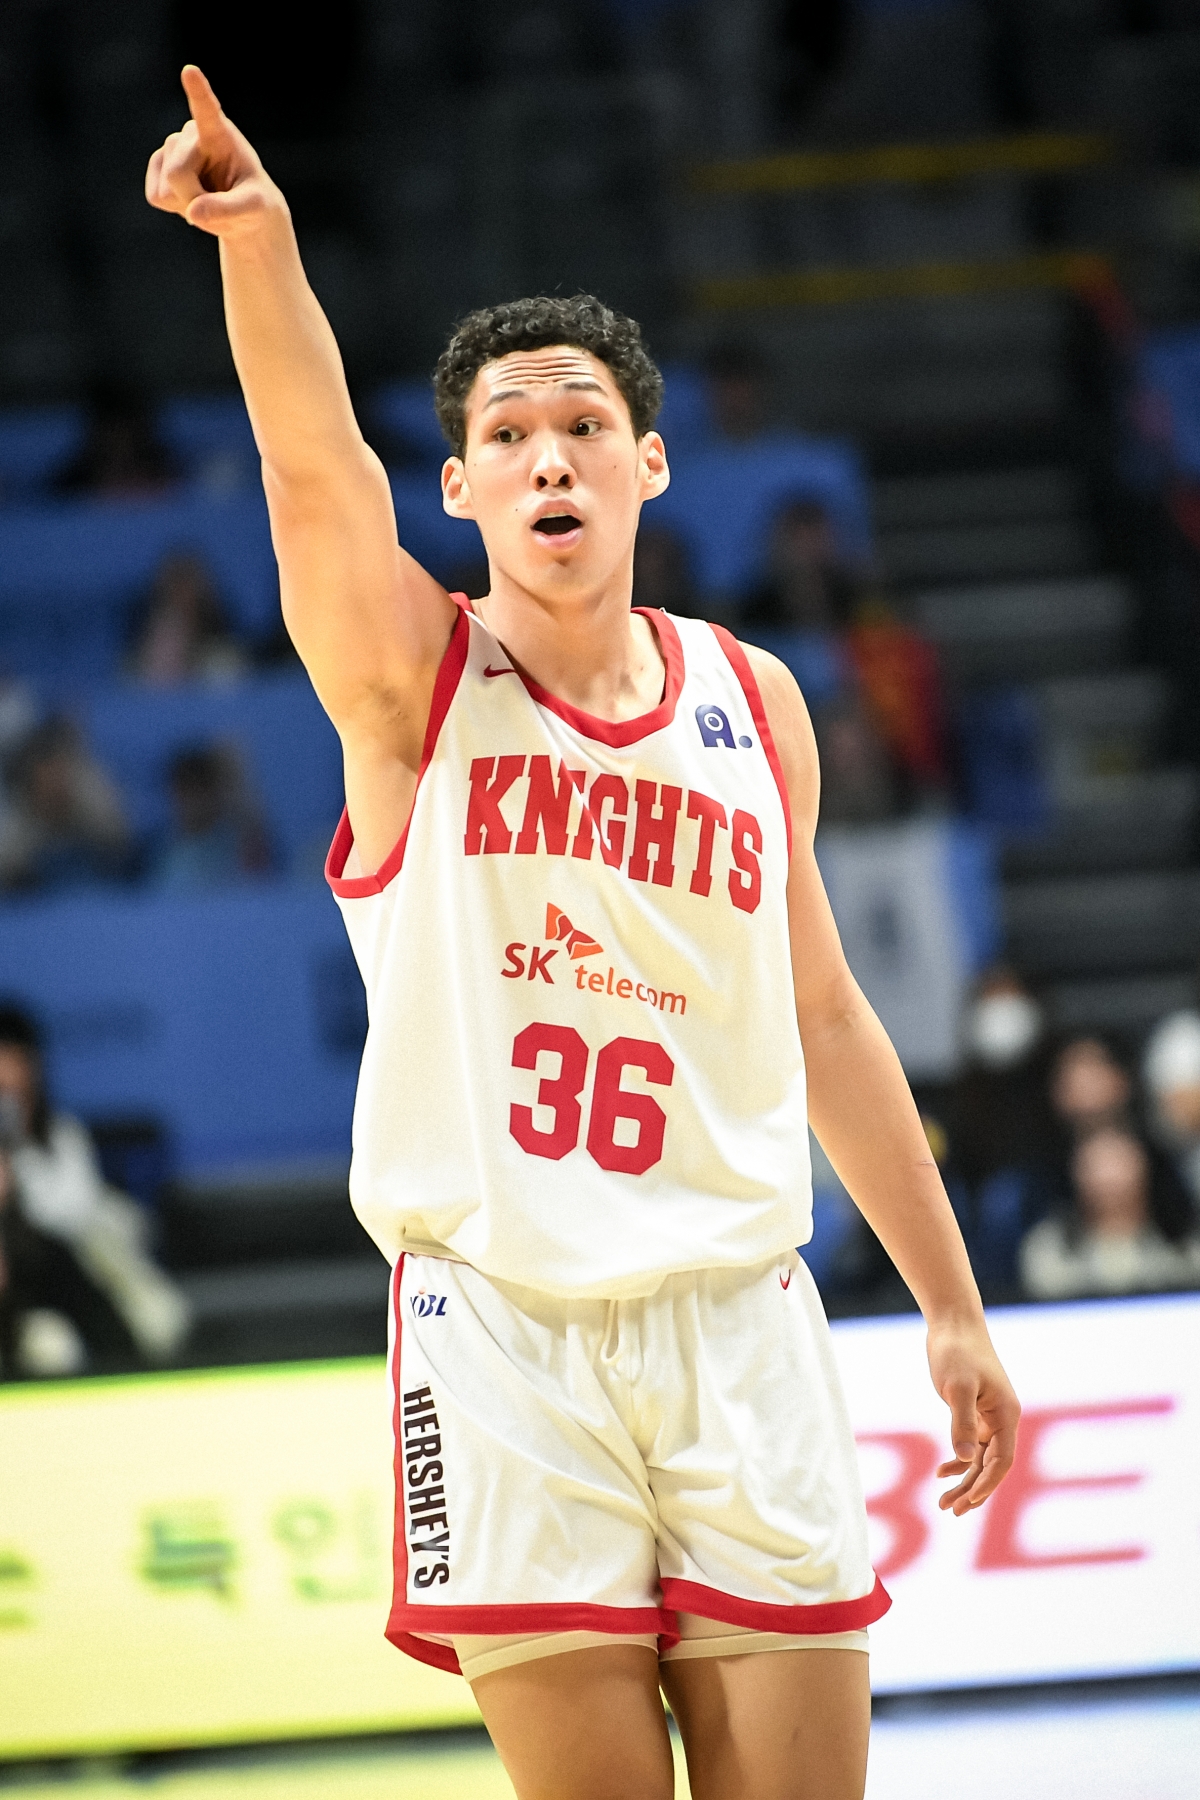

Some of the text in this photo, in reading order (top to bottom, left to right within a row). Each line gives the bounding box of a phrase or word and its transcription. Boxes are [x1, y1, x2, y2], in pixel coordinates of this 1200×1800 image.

[464, 754, 763, 914] KNIGHTS
[500, 942, 559, 985] SK
[574, 964, 687, 1016] telecom
[509, 1021, 675, 1176] 36
[403, 1386, 450, 1589] HERSHEY'S
